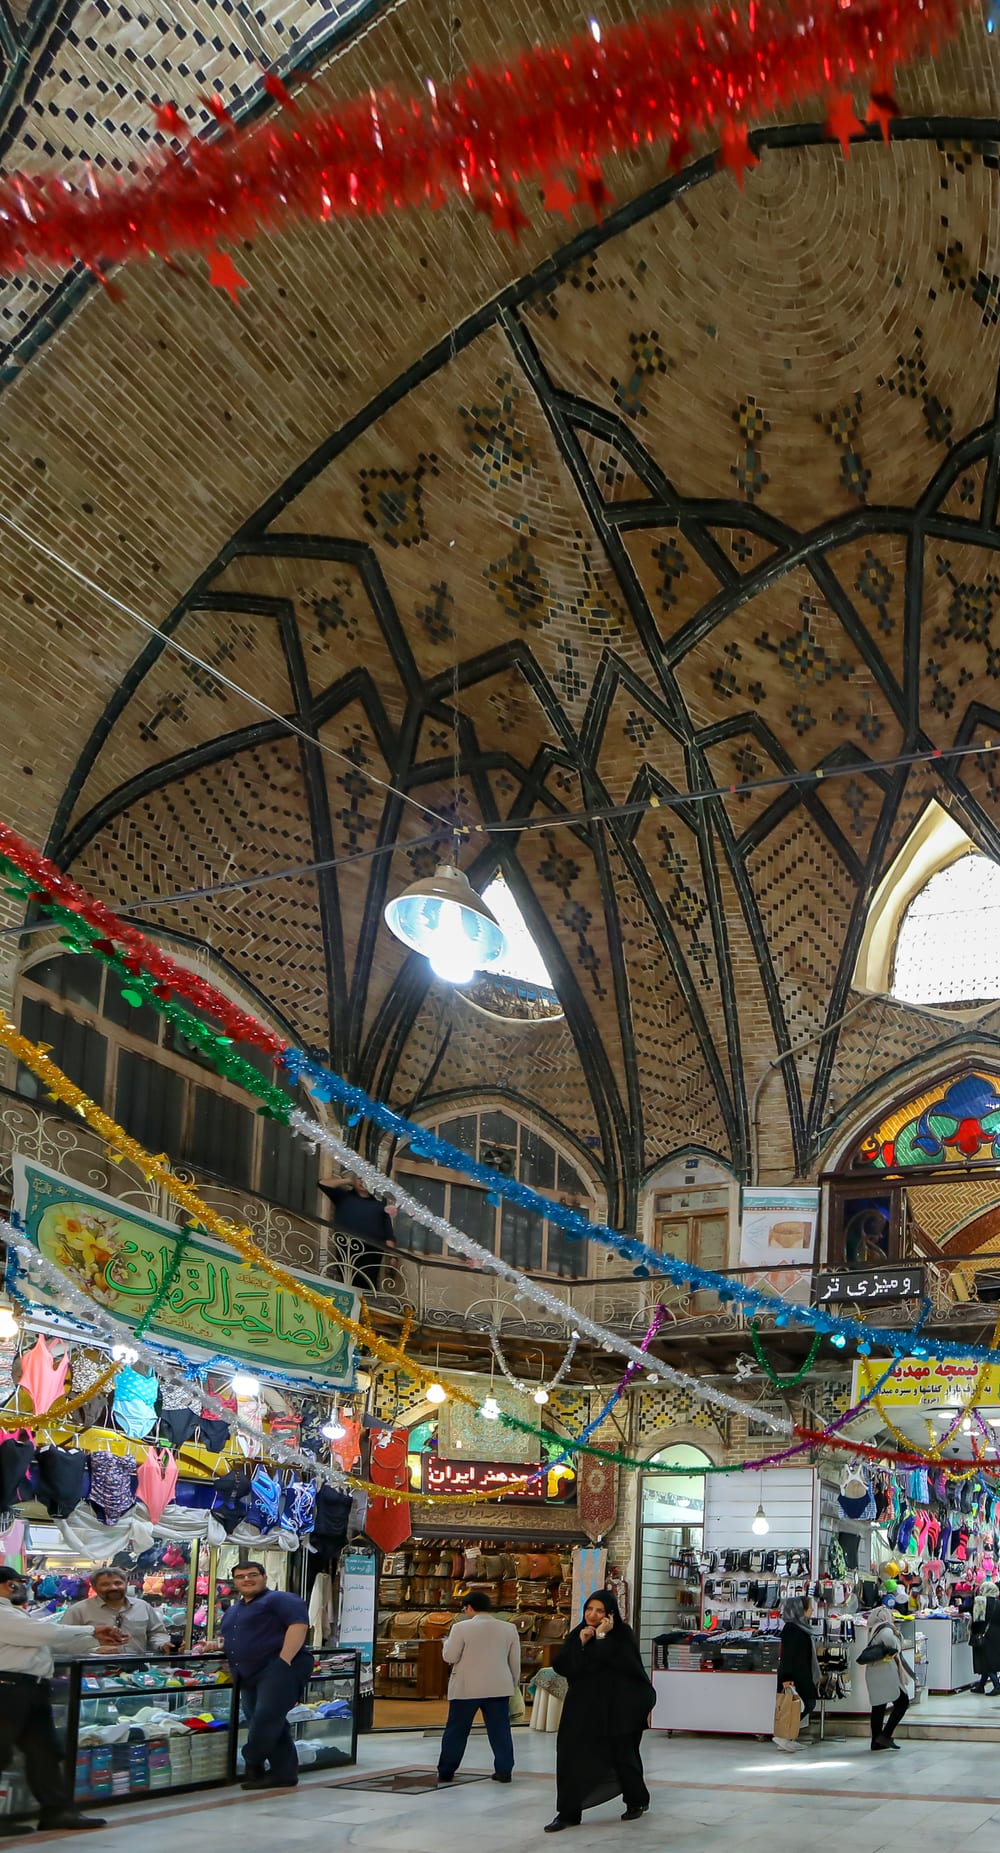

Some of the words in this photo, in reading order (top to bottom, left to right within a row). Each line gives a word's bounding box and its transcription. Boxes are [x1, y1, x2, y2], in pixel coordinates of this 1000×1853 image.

[934, 1360, 979, 1381] تیمچه
[913, 1388, 918, 1396] و
[429, 1465, 475, 1484] ایران
